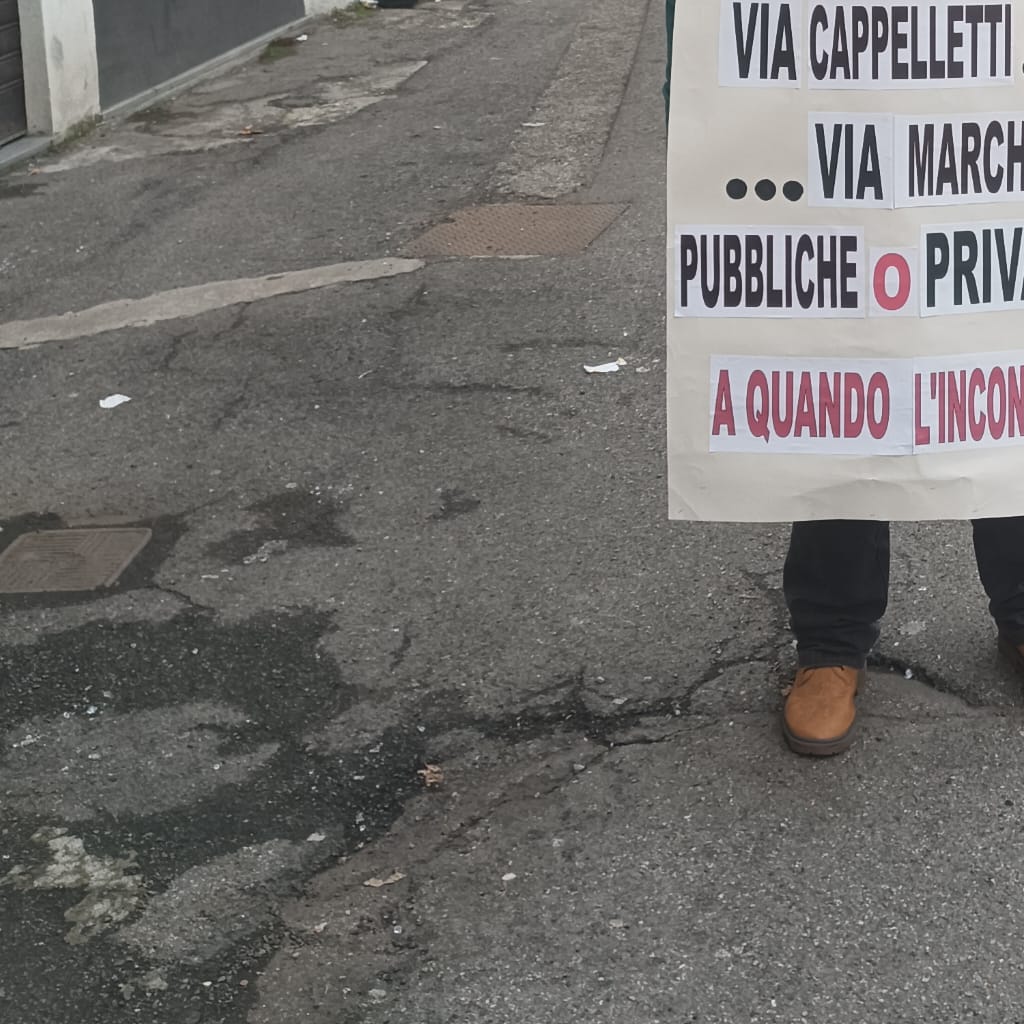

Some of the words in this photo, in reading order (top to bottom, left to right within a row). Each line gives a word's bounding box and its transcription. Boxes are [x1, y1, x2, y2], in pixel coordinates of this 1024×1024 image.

[733, 3, 796, 80] VIA
[681, 234, 857, 308] PUBBLICHE
[712, 370, 735, 435] A
[746, 370, 889, 440] QUANDO
